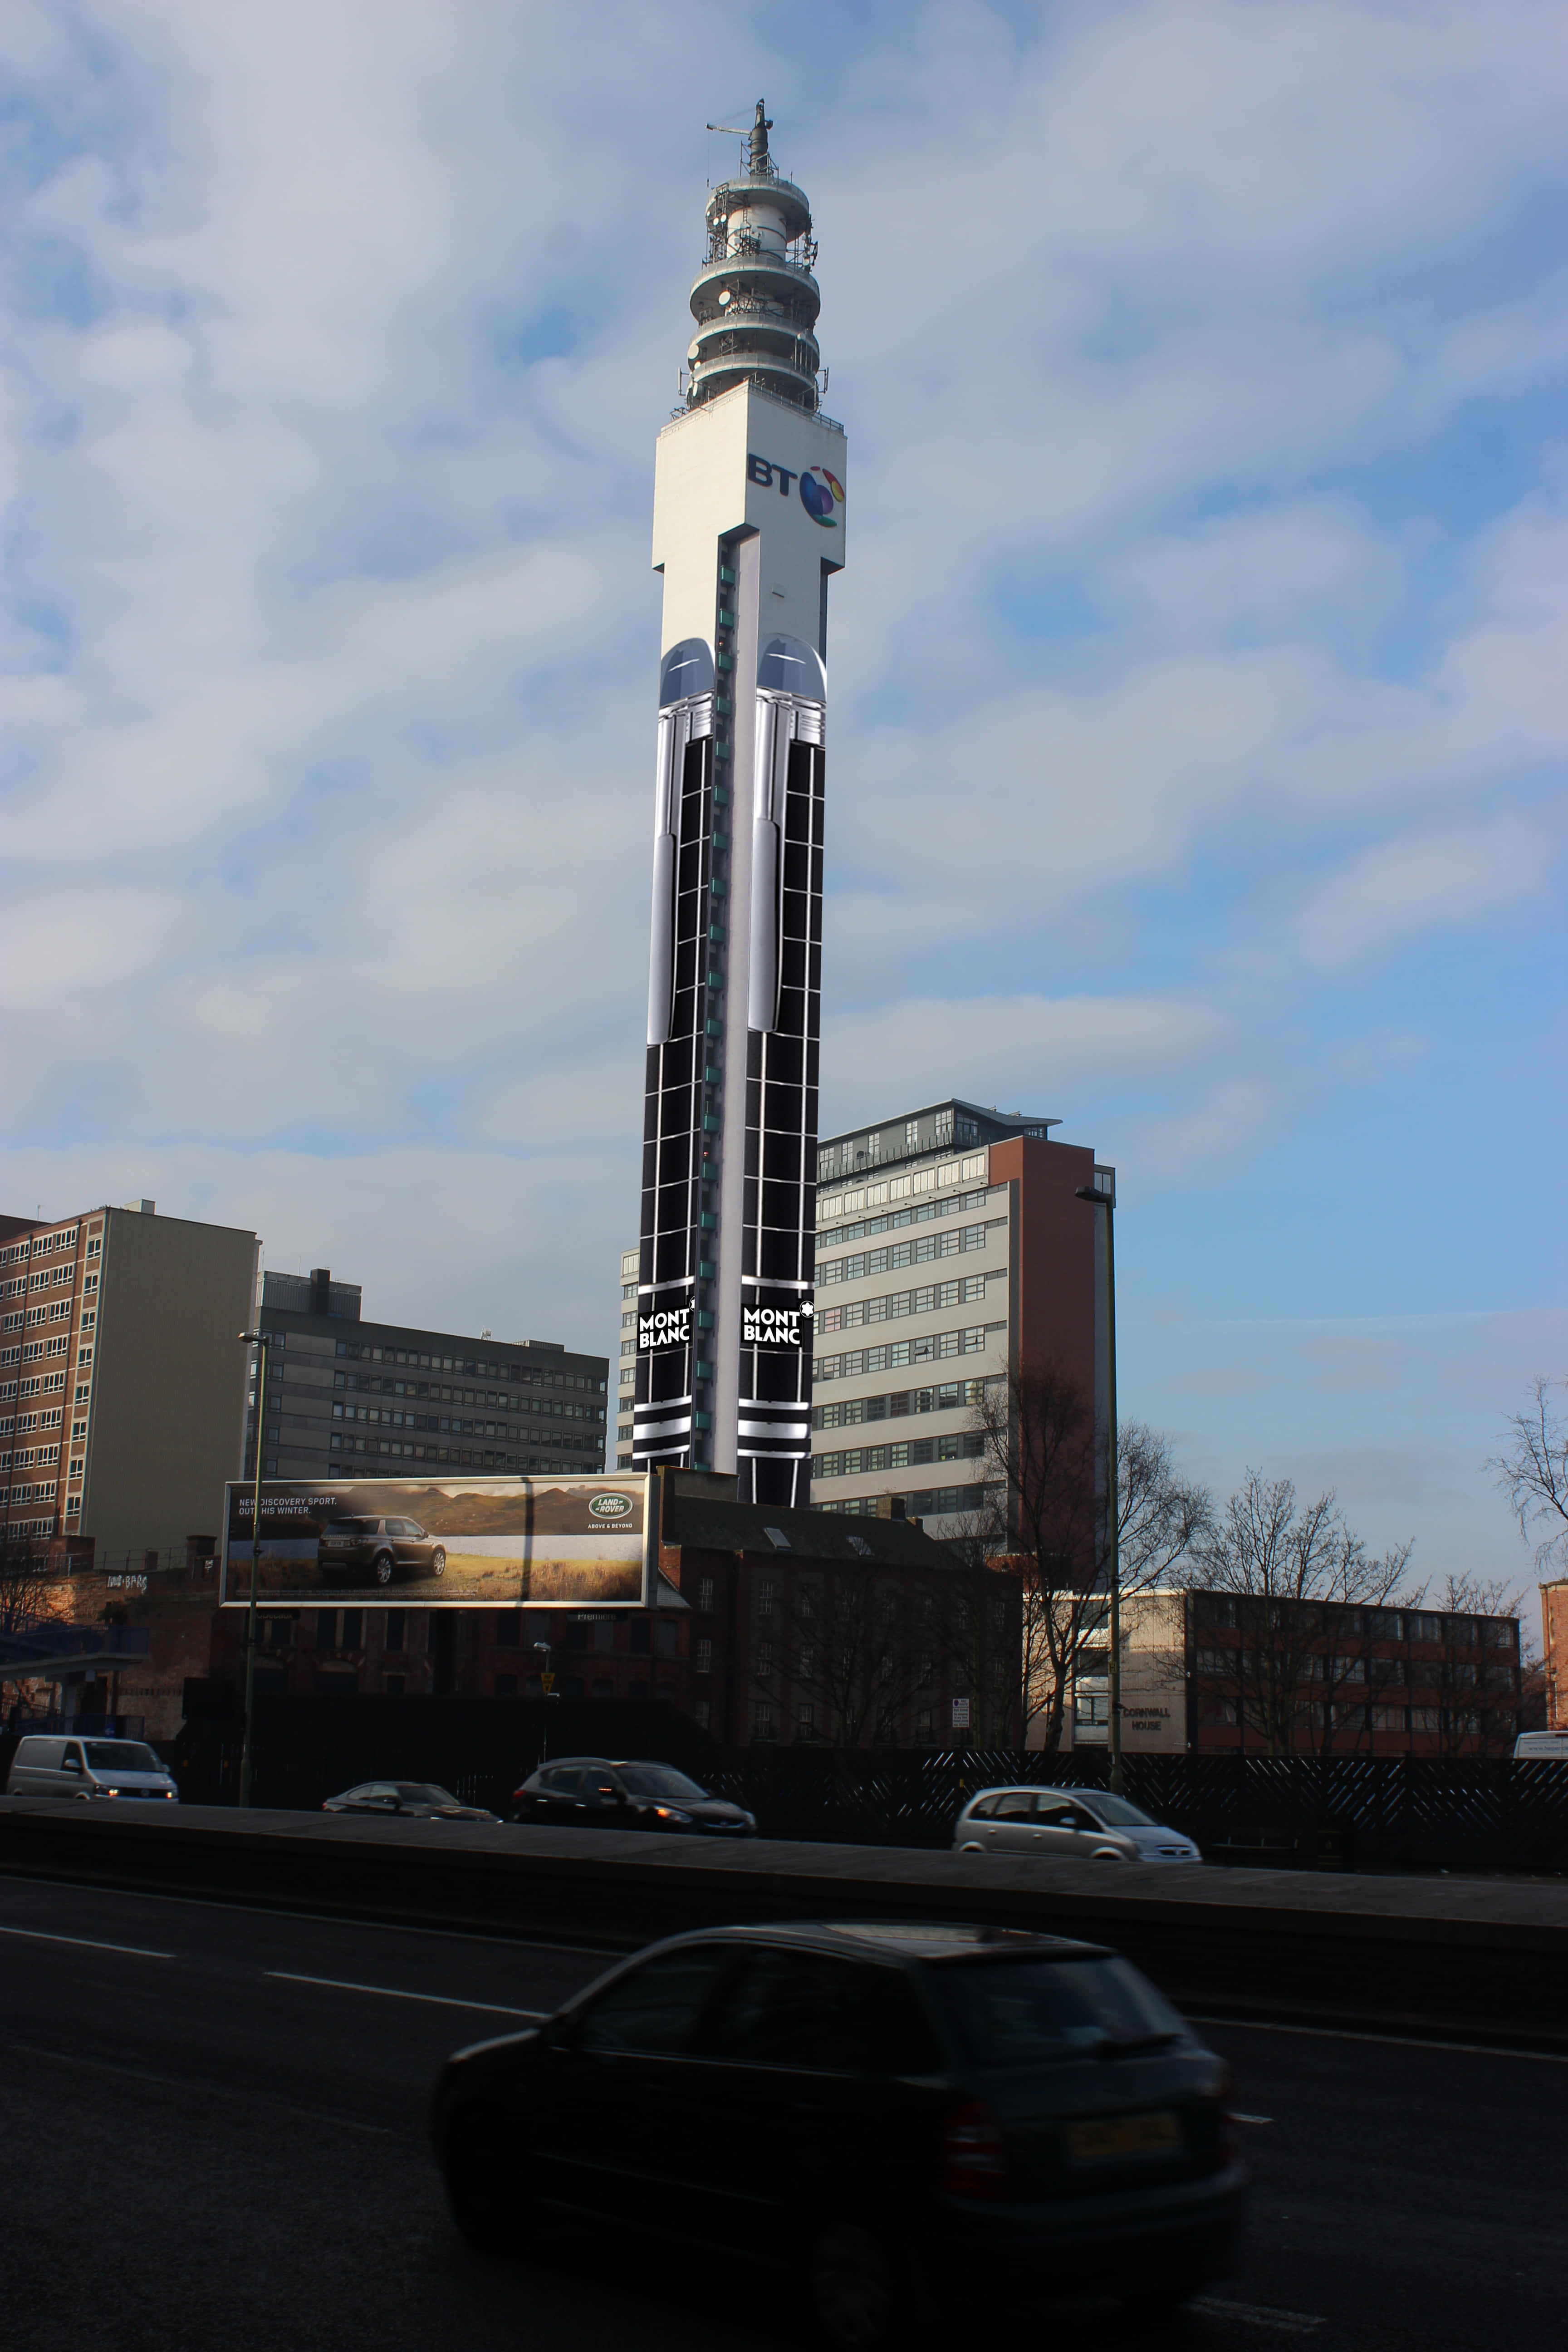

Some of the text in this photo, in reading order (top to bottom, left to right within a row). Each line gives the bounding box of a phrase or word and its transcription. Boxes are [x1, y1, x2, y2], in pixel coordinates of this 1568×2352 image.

[748, 453, 798, 496] BT
[640, 1308, 690, 1332] MONT
[744, 1307, 800, 1327] MONT
[640, 1324, 690, 1348] BLANC
[744, 1324, 800, 1344] BLANC
[308, 1497, 337, 1505] SPORT.
[1123, 1707, 1171, 1717] CORNWALL
[1132, 1720, 1161, 1731] HOUSE
